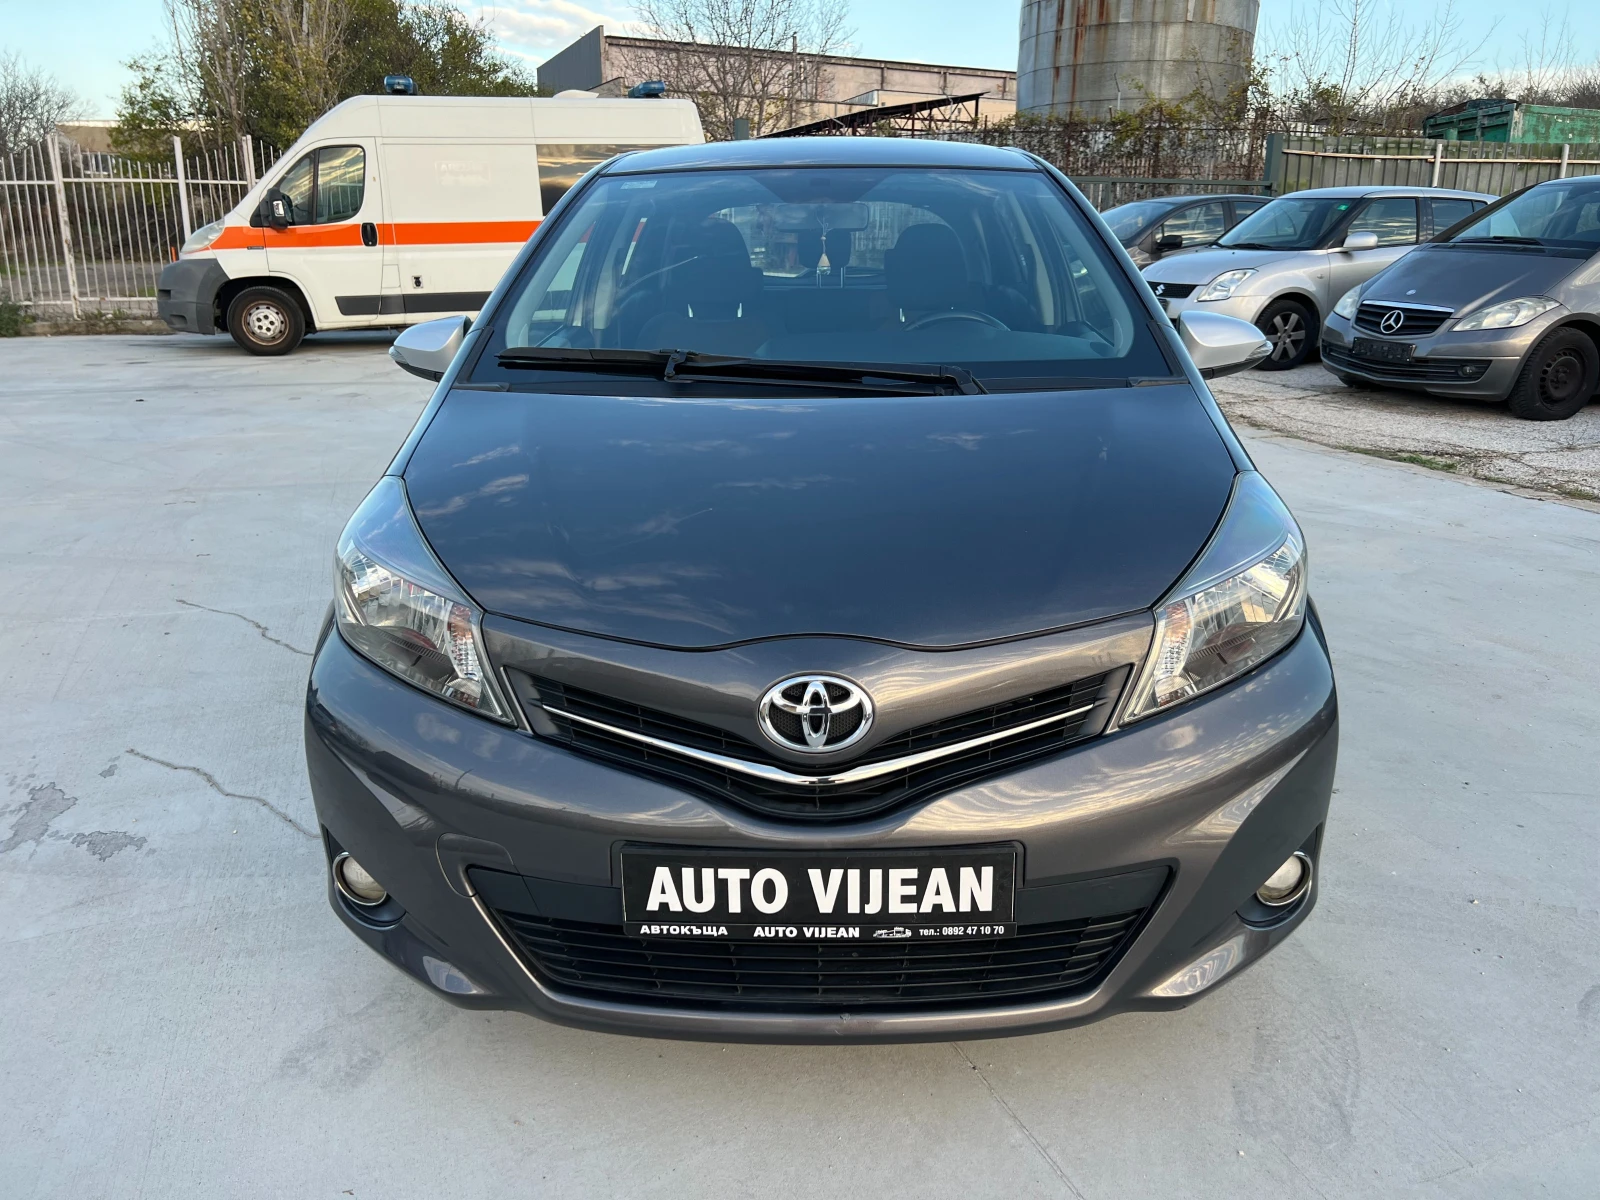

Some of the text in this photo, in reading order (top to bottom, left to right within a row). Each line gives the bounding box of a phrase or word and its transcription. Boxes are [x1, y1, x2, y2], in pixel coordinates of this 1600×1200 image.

[646, 865, 994, 914] AUTO VIJEAN
[639, 925, 729, 936] АВТОКЪЩА
[753, 926, 860, 938] AUTO VIJEAN
[918, 925, 1005, 936] тел.: 0892 47 10 70
